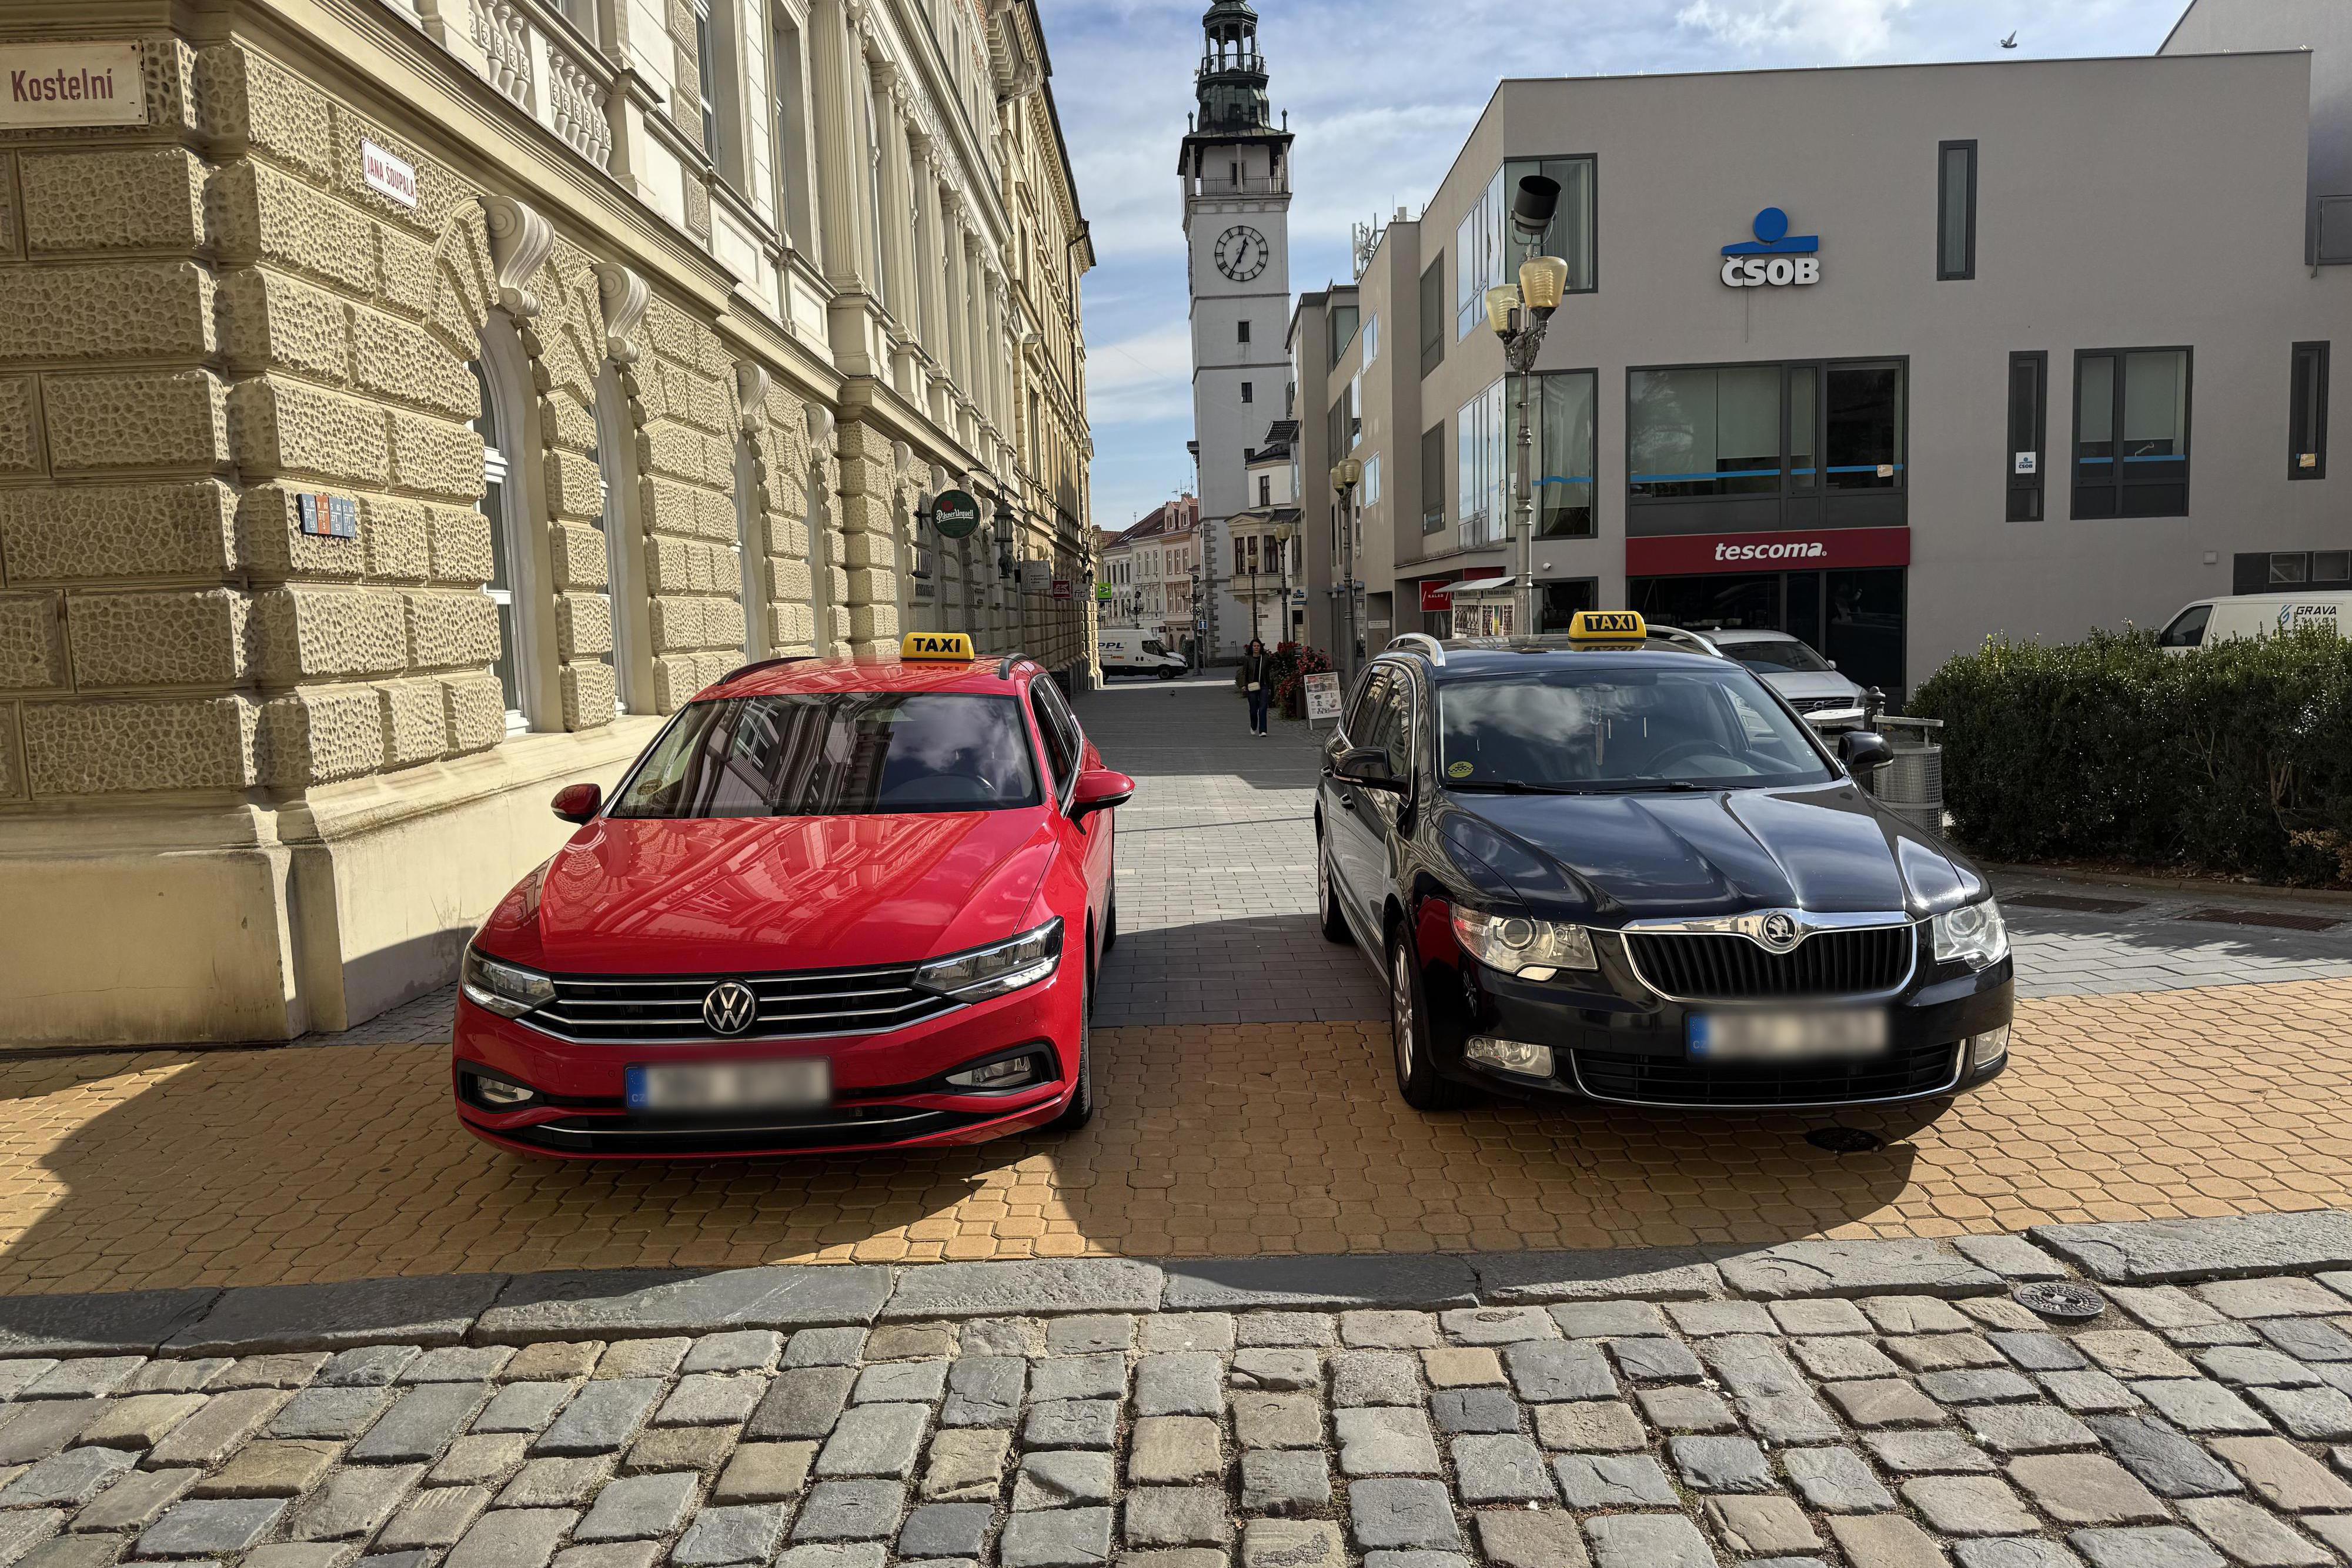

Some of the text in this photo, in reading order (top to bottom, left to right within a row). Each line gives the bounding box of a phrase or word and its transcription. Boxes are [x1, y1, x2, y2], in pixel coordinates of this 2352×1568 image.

[11, 68, 113, 102] Kostelní
[368, 155, 415, 199] JANA ŠOUPALA
[1721, 256, 1820, 287] ČSOB
[936, 509, 974, 524] Pilsner Urquell
[2296, 606, 2337, 615] GRAVA
[1587, 616, 1633, 629] TAXI
[913, 638, 960, 653] TAXI
[632, 1094, 645, 1102] CZ
